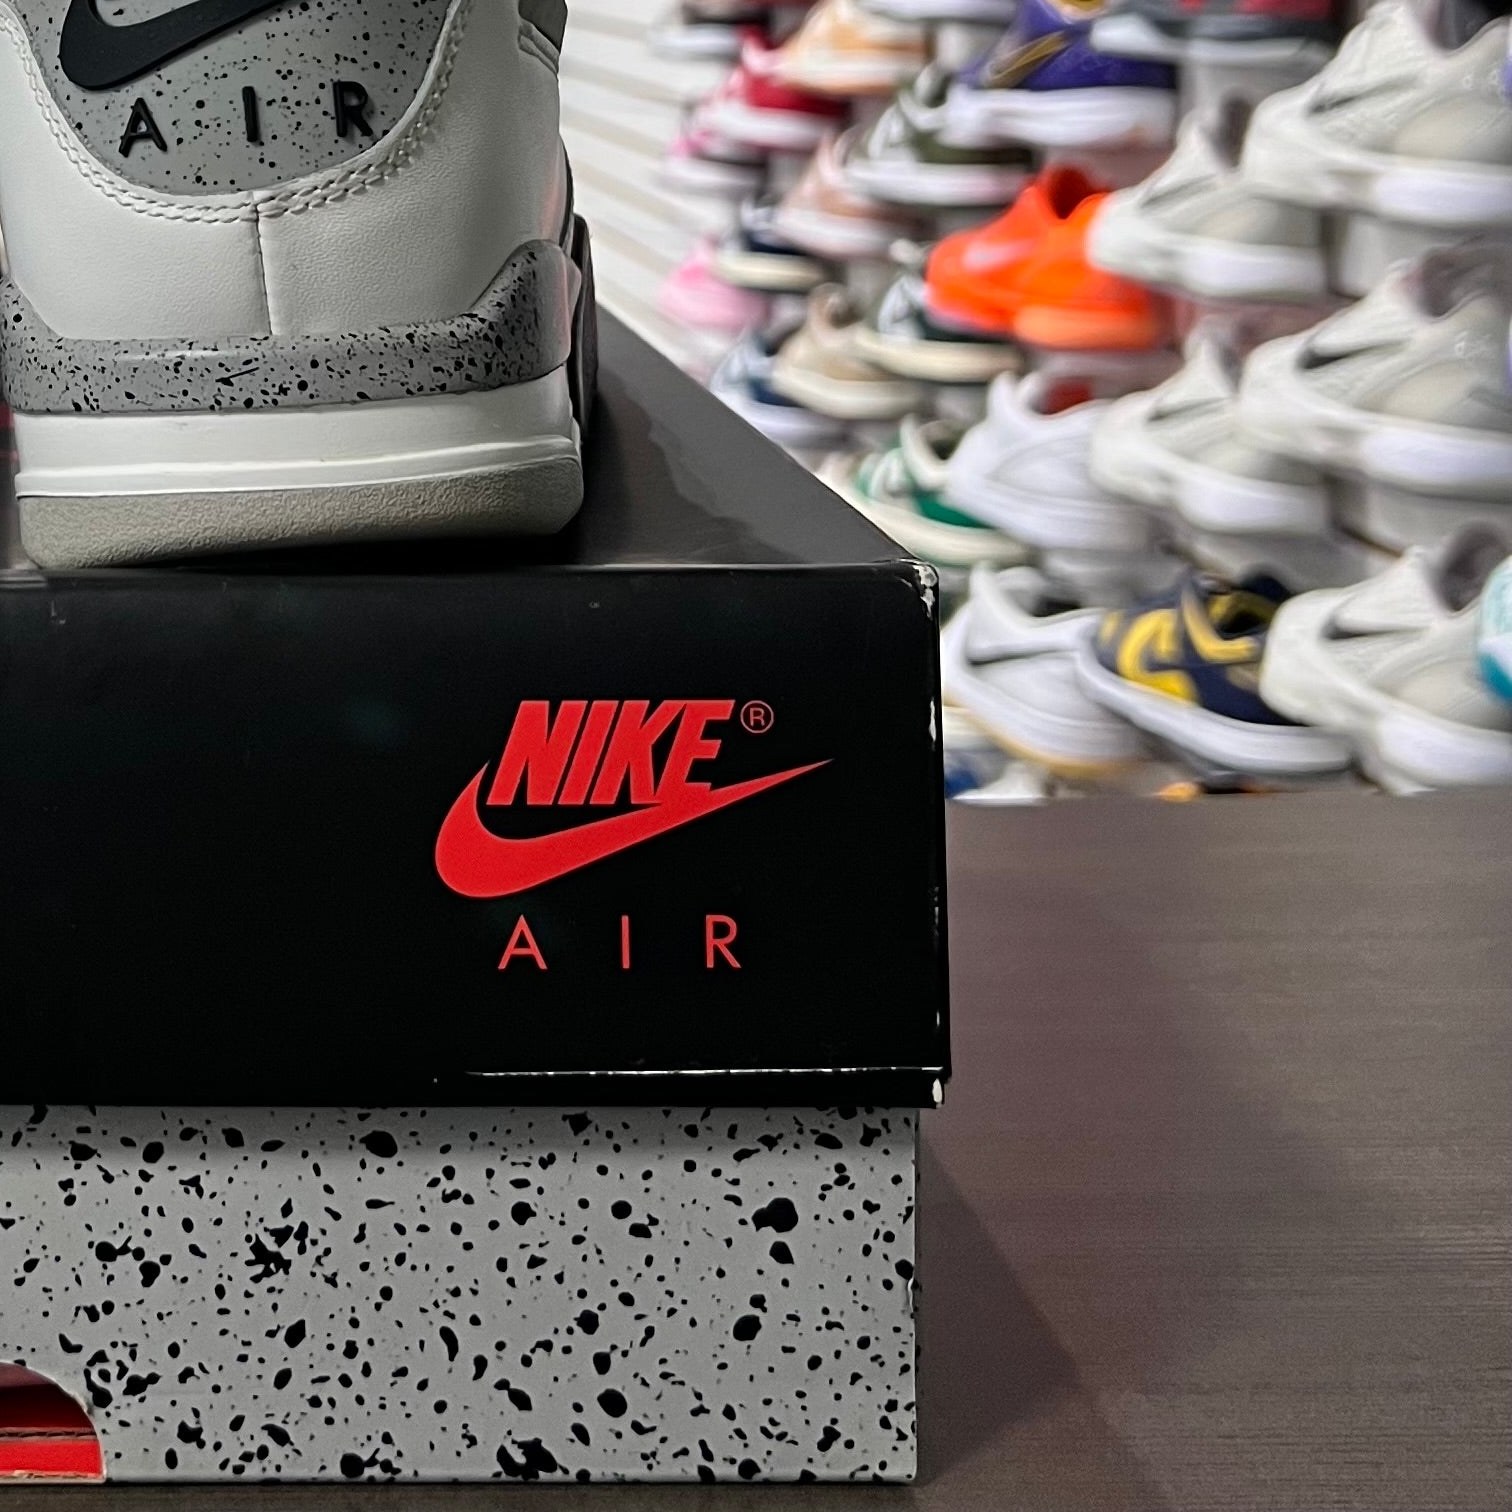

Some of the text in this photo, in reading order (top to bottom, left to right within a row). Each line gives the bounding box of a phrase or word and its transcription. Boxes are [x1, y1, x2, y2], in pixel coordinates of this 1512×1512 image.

[118, 80, 374, 158] AIR
[486, 699, 736, 806] NIKE
[498, 914, 742, 970] AIR
